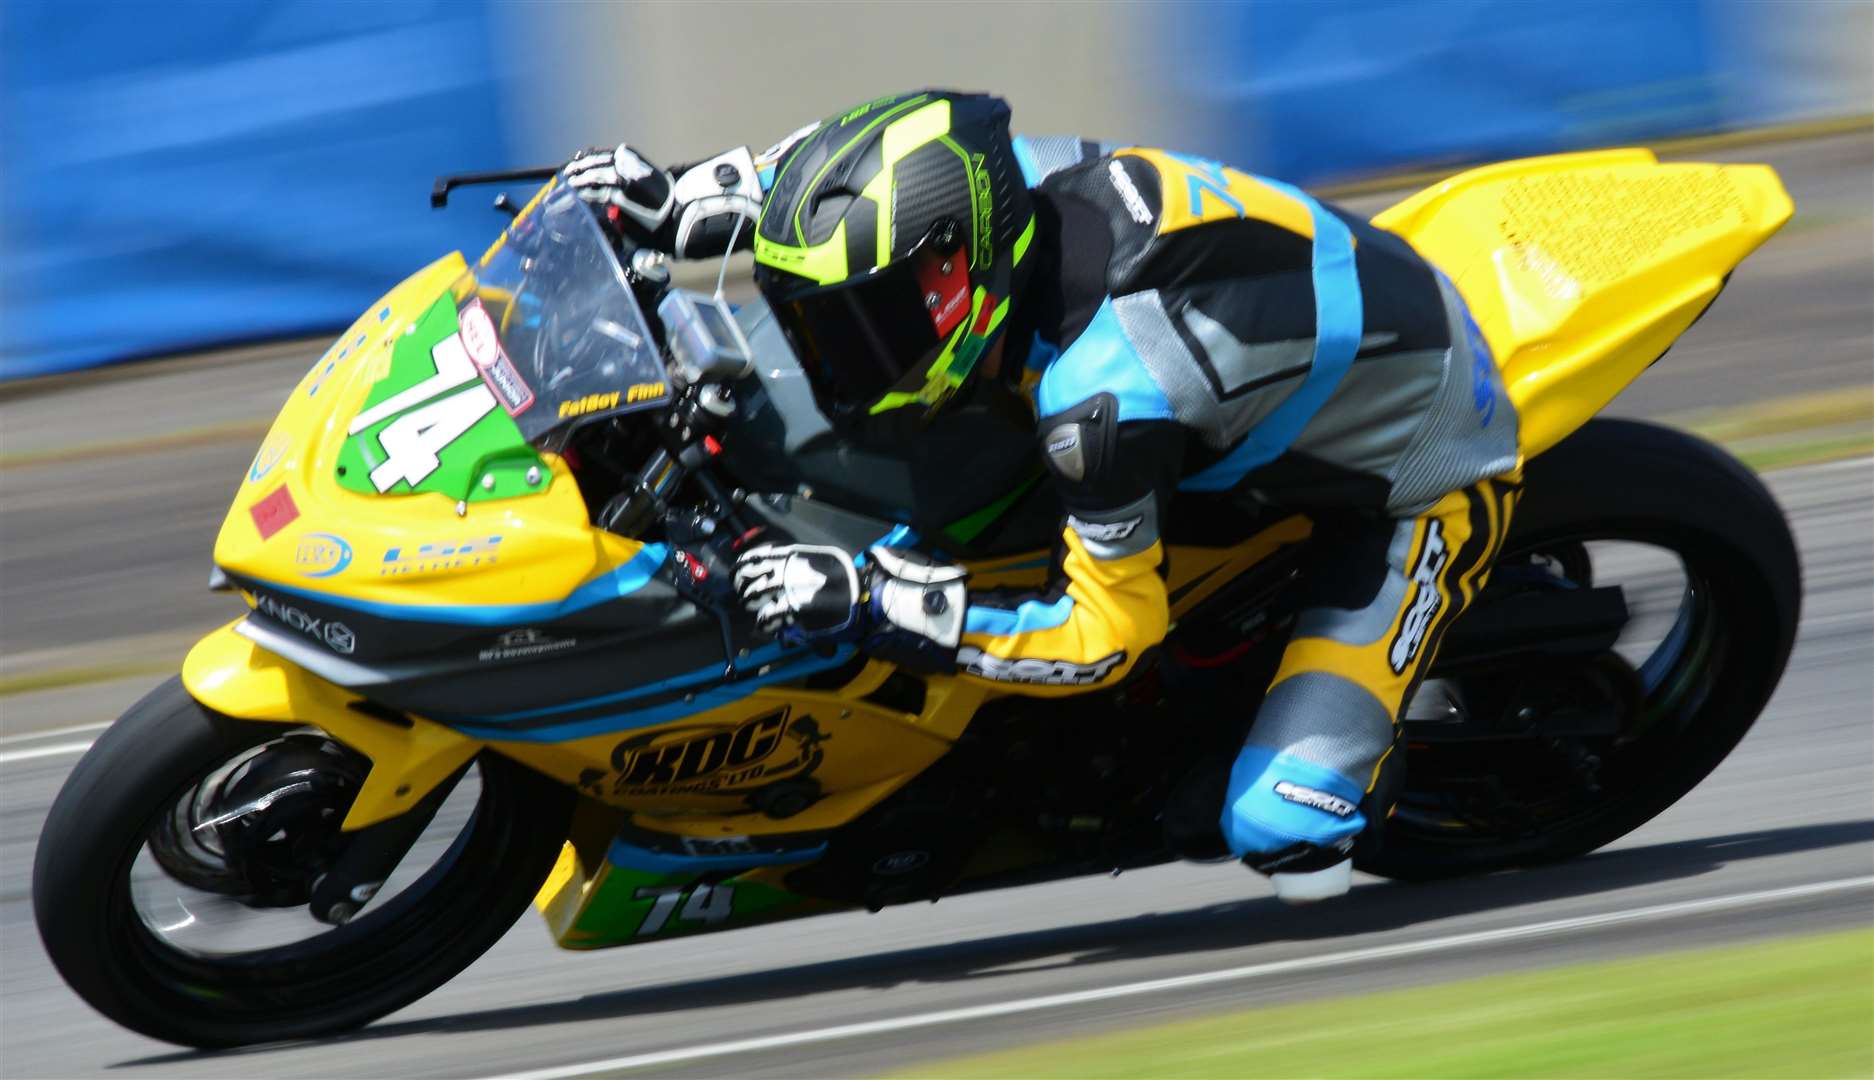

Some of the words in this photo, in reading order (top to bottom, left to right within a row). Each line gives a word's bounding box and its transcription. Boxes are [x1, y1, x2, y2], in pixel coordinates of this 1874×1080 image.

[348, 330, 499, 495] 74
[627, 381, 665, 404] Finn
[252, 590, 322, 641] KNOX
[632, 881, 737, 937] 74
